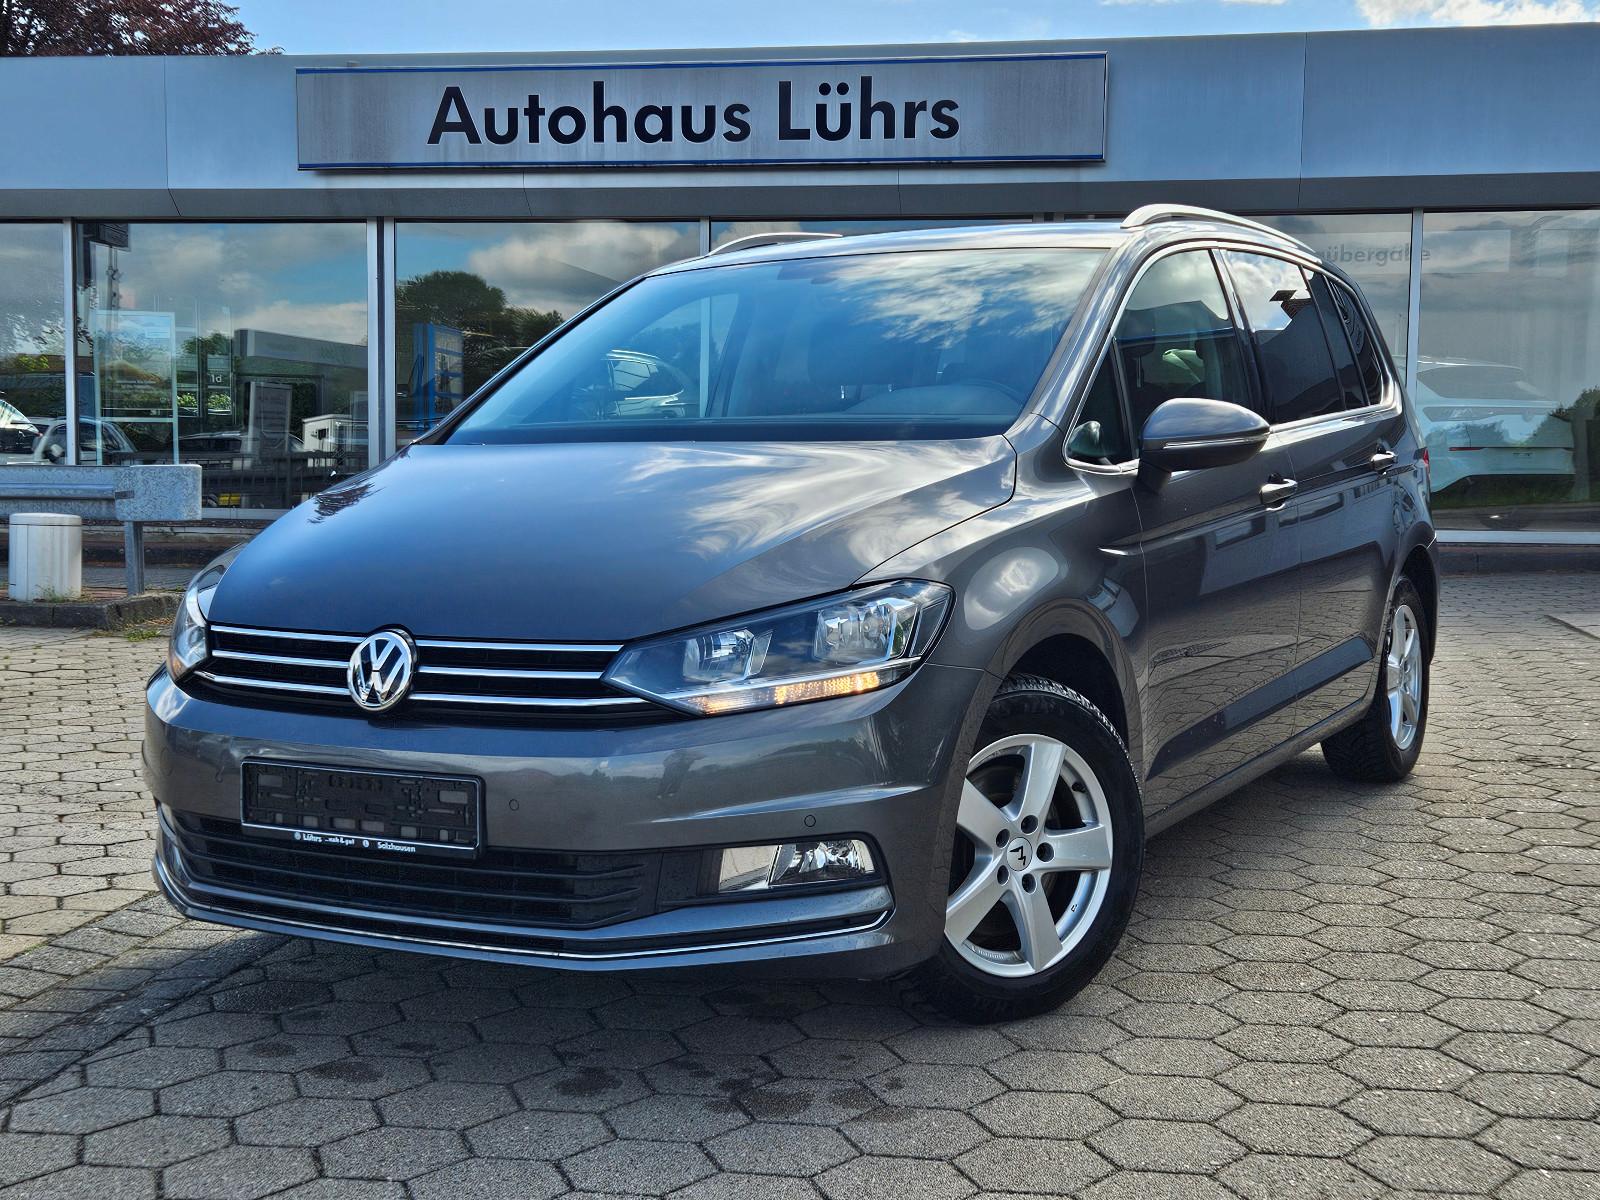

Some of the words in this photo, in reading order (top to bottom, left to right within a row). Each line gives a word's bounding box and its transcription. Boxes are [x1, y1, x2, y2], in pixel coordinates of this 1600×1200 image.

[427, 80, 752, 146] Autohaus
[777, 76, 961, 142] Lührs
[346, 631, 413, 711] VW
